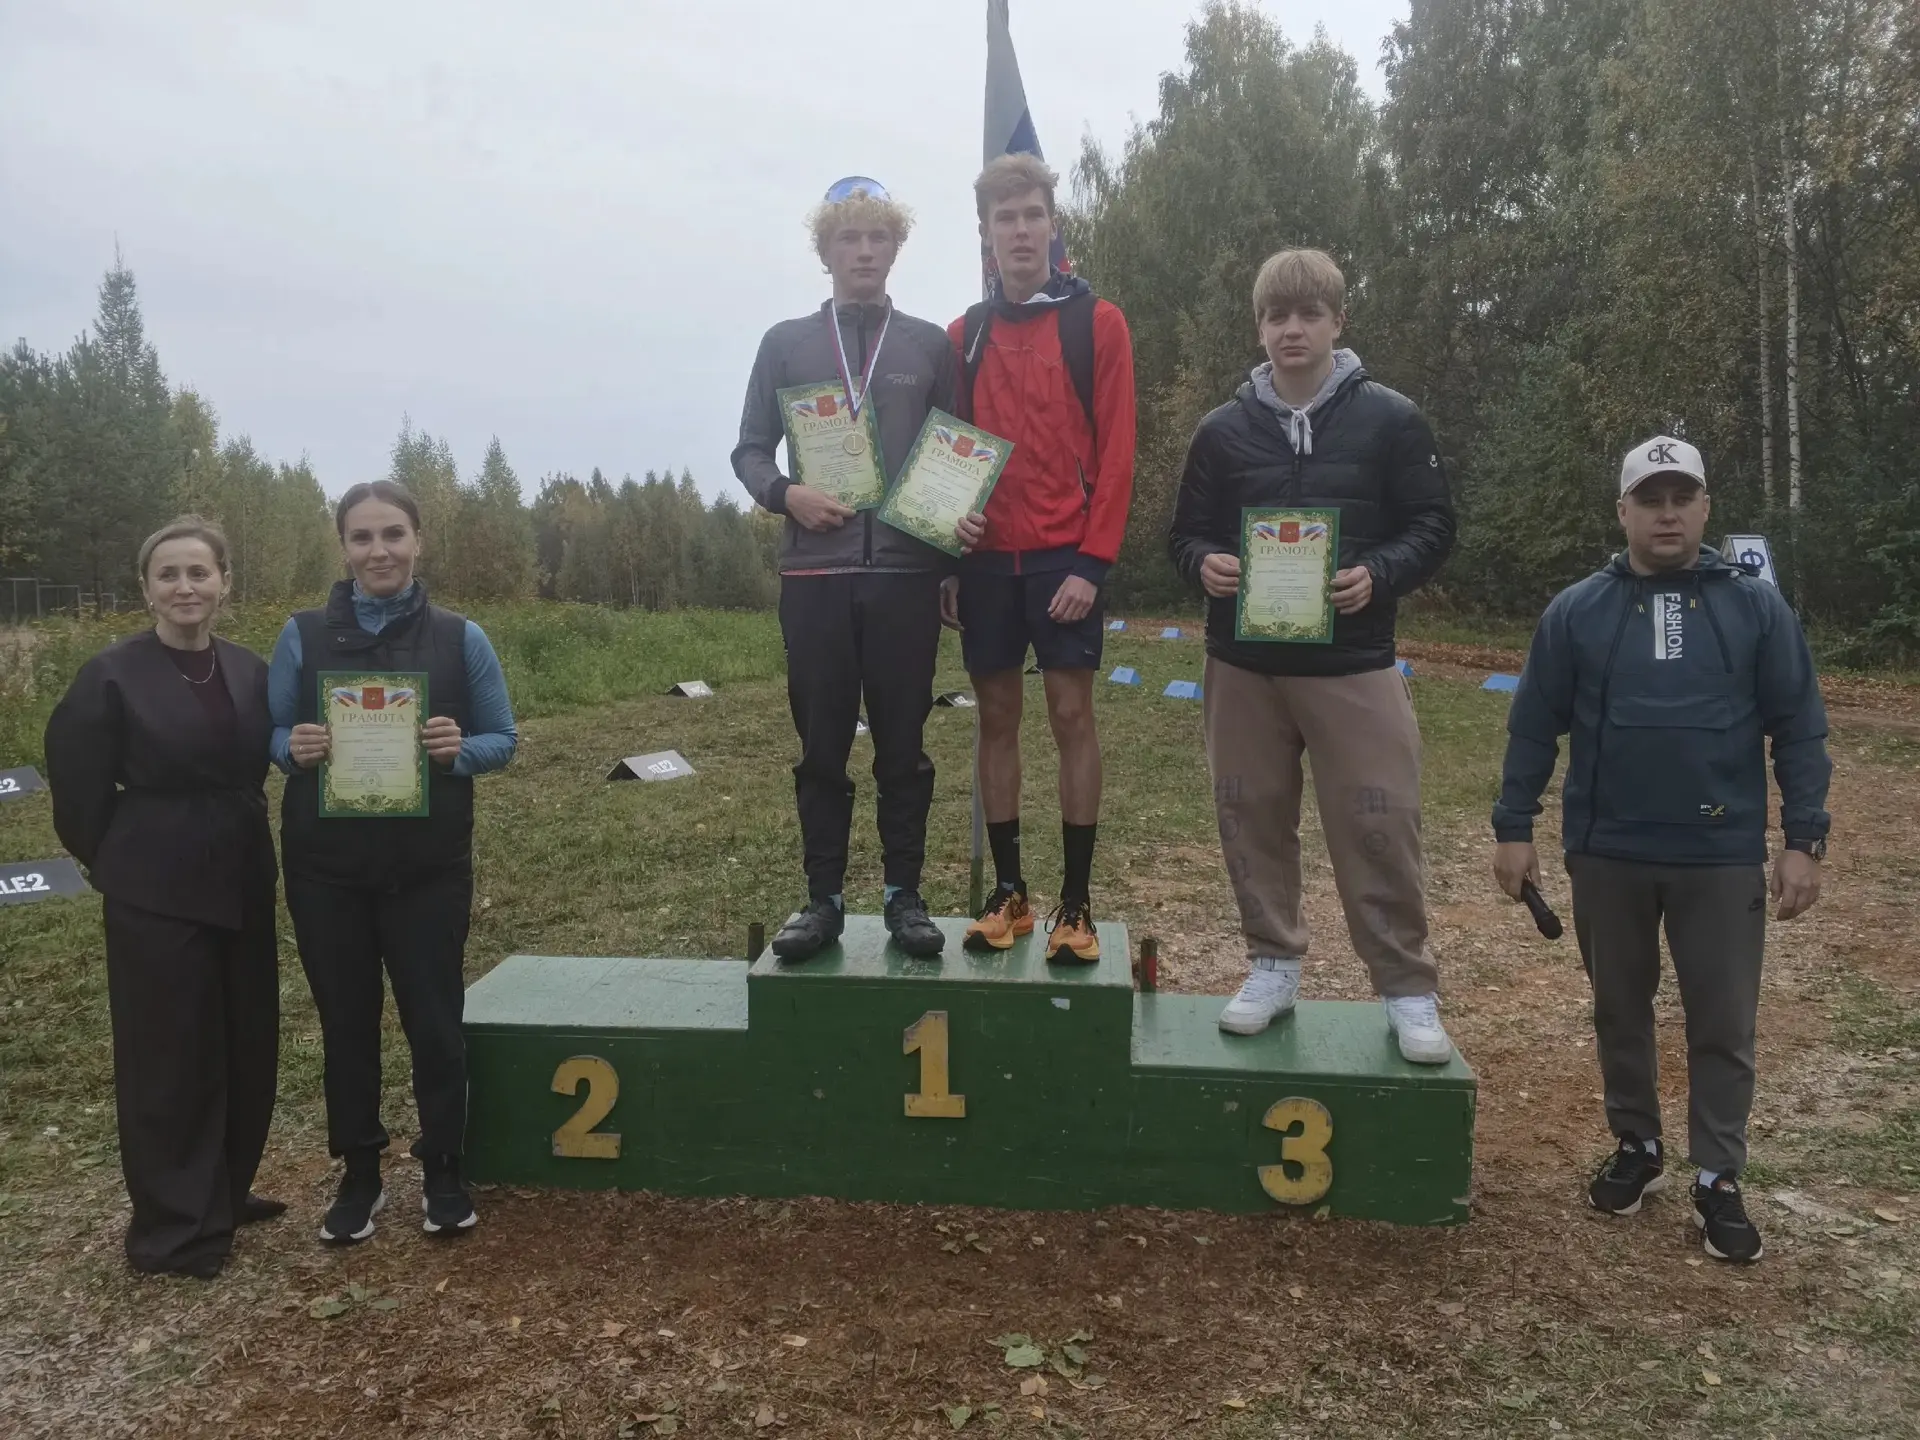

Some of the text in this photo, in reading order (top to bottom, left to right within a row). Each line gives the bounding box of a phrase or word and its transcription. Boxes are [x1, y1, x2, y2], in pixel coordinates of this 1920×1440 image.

[803, 416, 850, 432] ГРАМОТ
[850, 435, 857, 449] 1
[931, 447, 981, 475] ГРАМОТА
[1260, 545, 1316, 555] ГРАМОТА
[1665, 593, 1683, 660] FASHION
[341, 713, 405, 723] ГРАМОТА
[0, 873, 50, 894] LE2
[903, 1010, 966, 1118] 1
[551, 1055, 622, 1158] 2
[1257, 1096, 1333, 1204] 3
